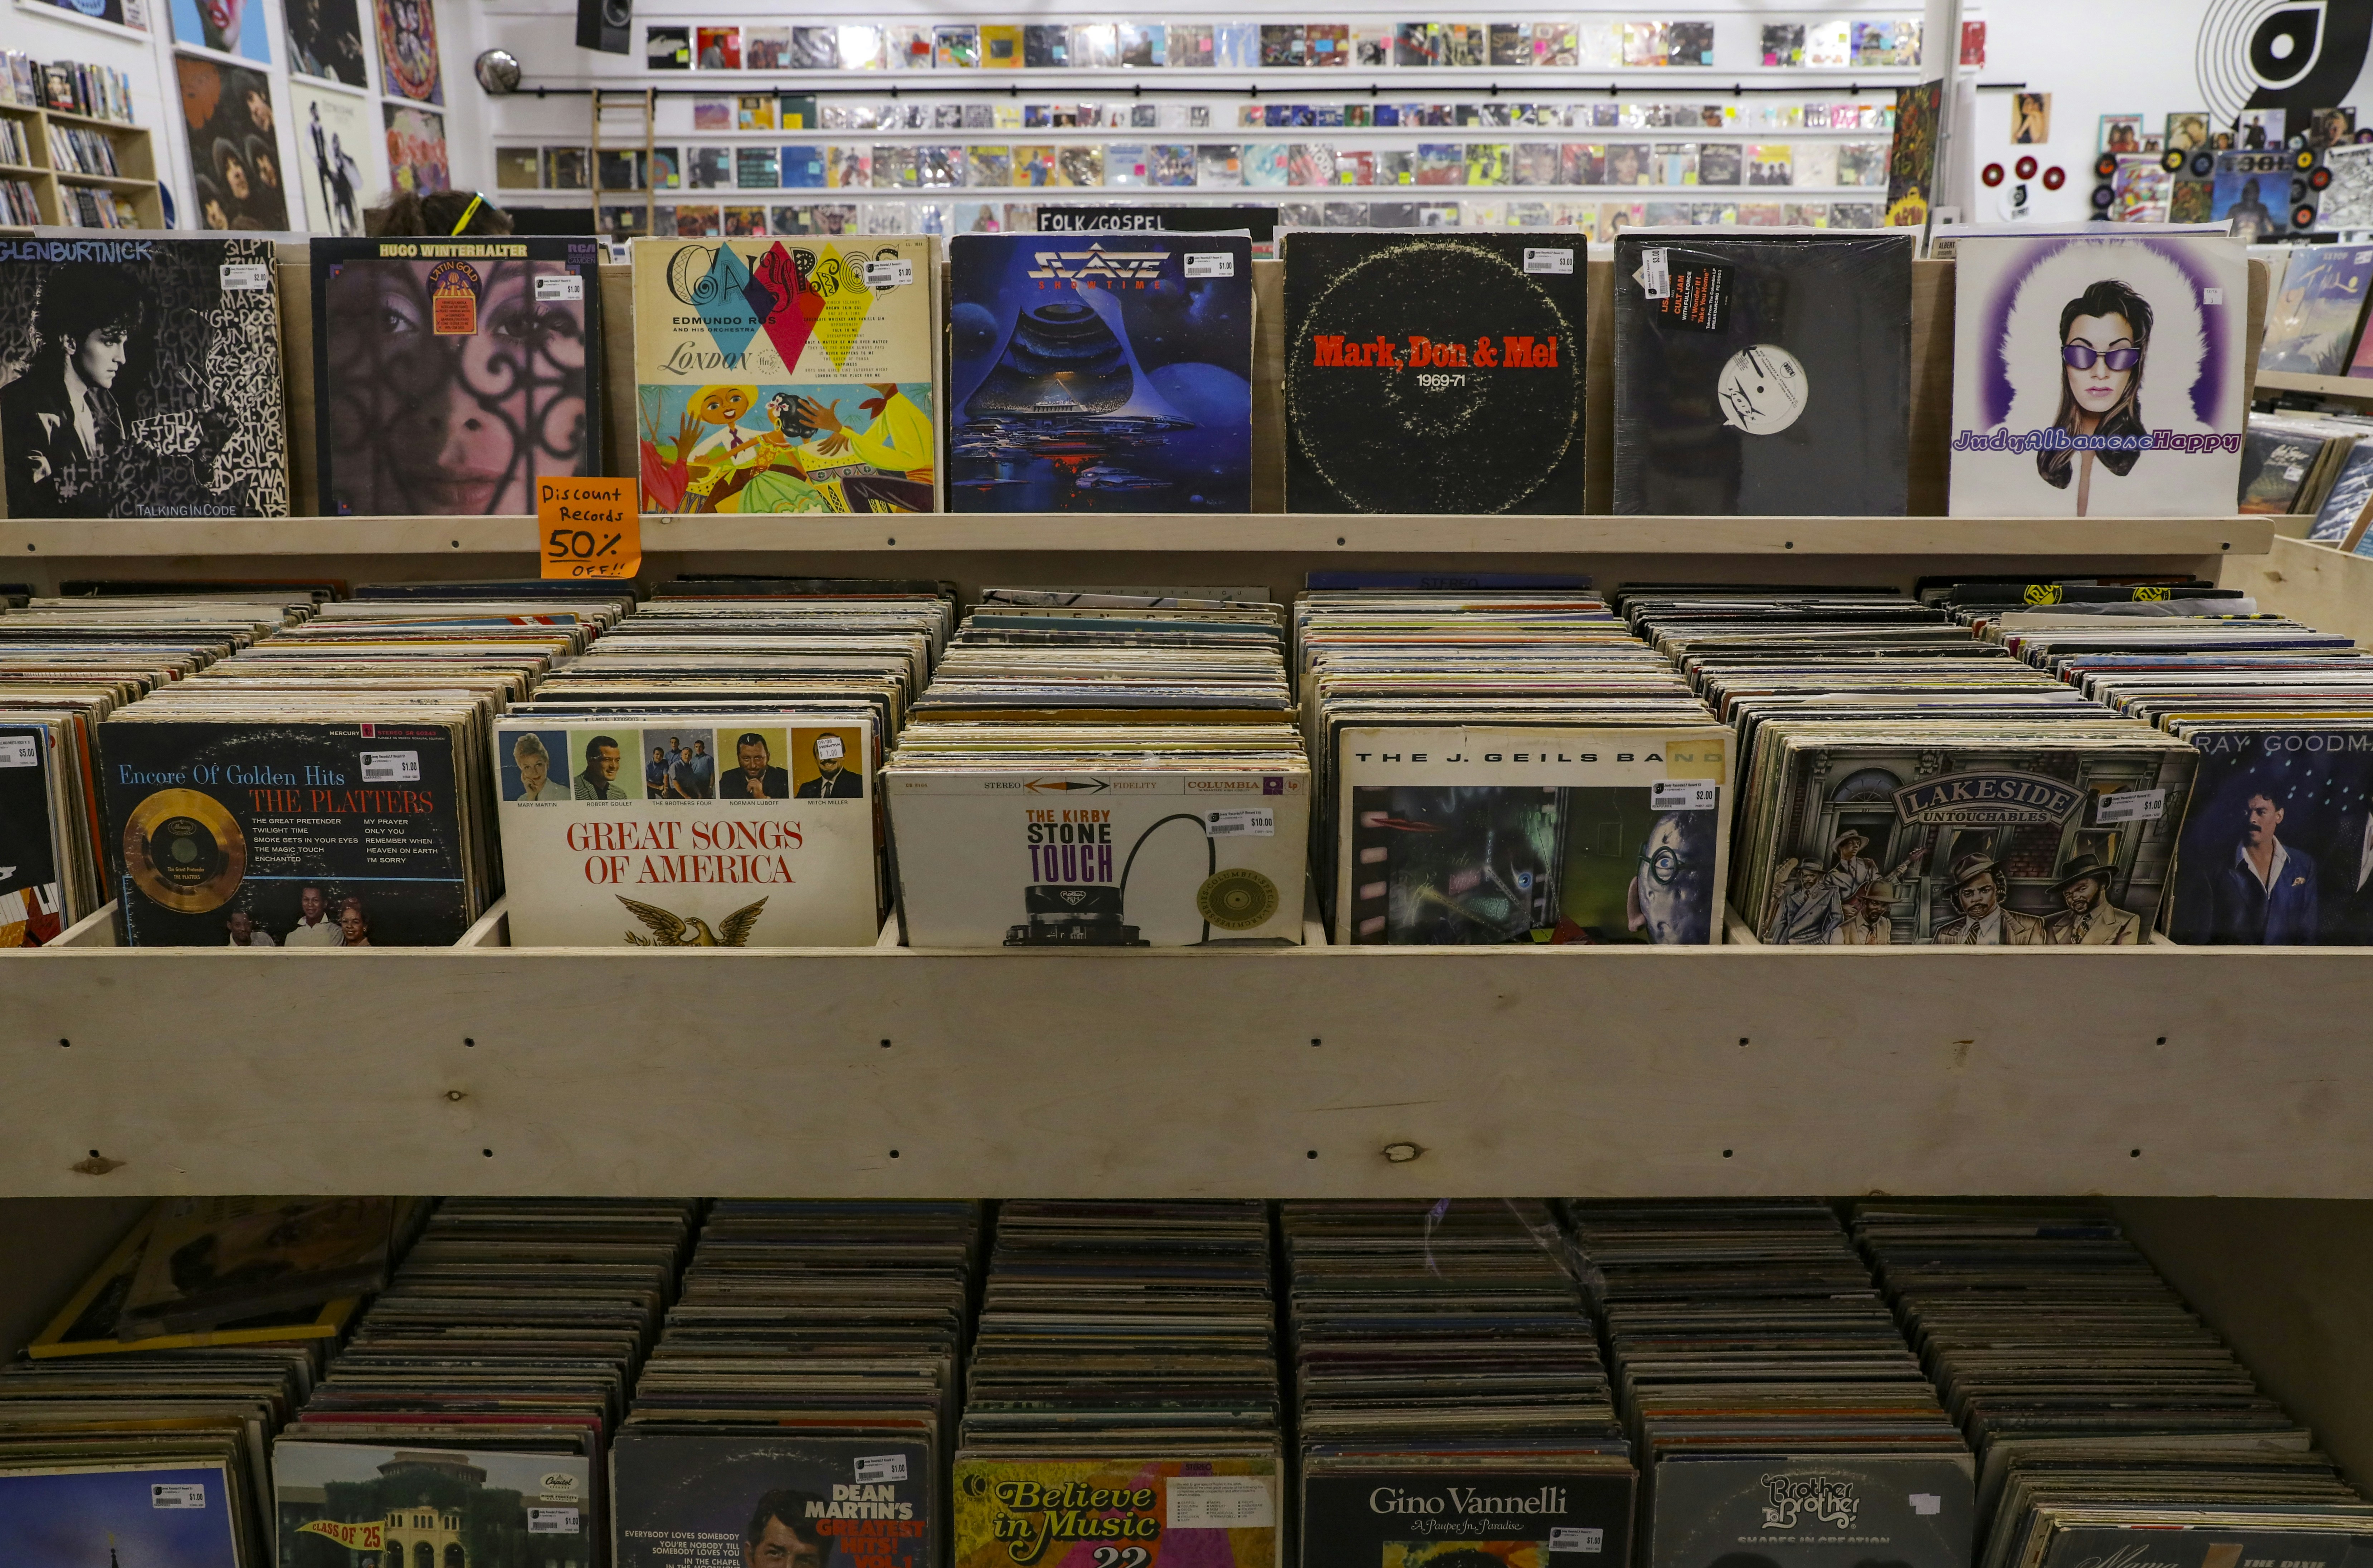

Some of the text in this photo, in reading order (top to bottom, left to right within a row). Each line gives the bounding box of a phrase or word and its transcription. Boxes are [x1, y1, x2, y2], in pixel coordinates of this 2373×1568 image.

[1041, 214, 1165, 231] FOLK/GOSPEL
[380, 244, 527, 257] HUGO WINTERHALTER
[568, 244, 595, 253] RCA
[1027, 242, 1171, 278] SLAVE
[1219, 262, 1232, 270] $1.00
[430, 261, 478, 282] LATIN GOLD
[899, 268, 911, 277] $1.00
[1038, 281, 1160, 289] SHOWTIME
[1674, 294, 1682, 314] CULT
[657, 341, 752, 375] LONDON
[1314, 336, 1558, 372] Mark, Don & Mel
[1417, 374, 1466, 387] 1969-71
[542, 485, 622, 502] Discount
[560, 507, 623, 522] Records
[548, 529, 621, 558] 50%
[2196, 735, 2373, 752] RAY GOODM
[19, 748, 34, 757] $5.00
[1356, 753, 1723, 762] THE J. GEILS BAND
[119, 764, 345, 785] Encore Of Golden Hits
[402, 762, 416, 771] $1.00
[984, 781, 1020, 790] STEREO
[249, 790, 433, 813] THE PLATTERS
[1696, 790, 1712, 801] $2.00
[1906, 778, 2070, 811] LAKESIDE
[2144, 800, 2161, 811] $1.00
[1026, 810, 1110, 822] THE KIRBY
[1924, 811, 2049, 824] UNTOUCHABLES
[567, 821, 803, 851] GREAT SONGS
[1028, 823, 1111, 844] STONE
[585, 855, 796, 885] OF AMERICA
[1028, 845, 1112, 883] TOUCH
[892, 1464, 905, 1472] $1.00
[546, 1477, 572, 1485] Capitol
[833, 1484, 895, 1502] DEAN
[995, 1480, 1151, 1508] Believe
[1761, 1474, 1853, 1507] Brother
[1370, 1486, 1567, 1514] Gino Vannelli
[805, 1501, 913, 1519] MARTIN'S
[565, 1517, 578, 1525] $1.00
[816, 1520, 925, 1537] GREATEST
[1411, 1520, 1423, 1529] A
[1422, 1519, 1460, 1534] Pauper
[1475, 1518, 1524, 1534] Paradise
[313, 1523, 338, 1538] CLASS
[341, 1527, 355, 1544] OF
[625, 1530, 668, 1539] EVERYBODY
[994, 1509, 1158, 1562] in Music
[840, 1536, 898, 1554] HITS!
[1093, 1546, 1147, 1568] 22
